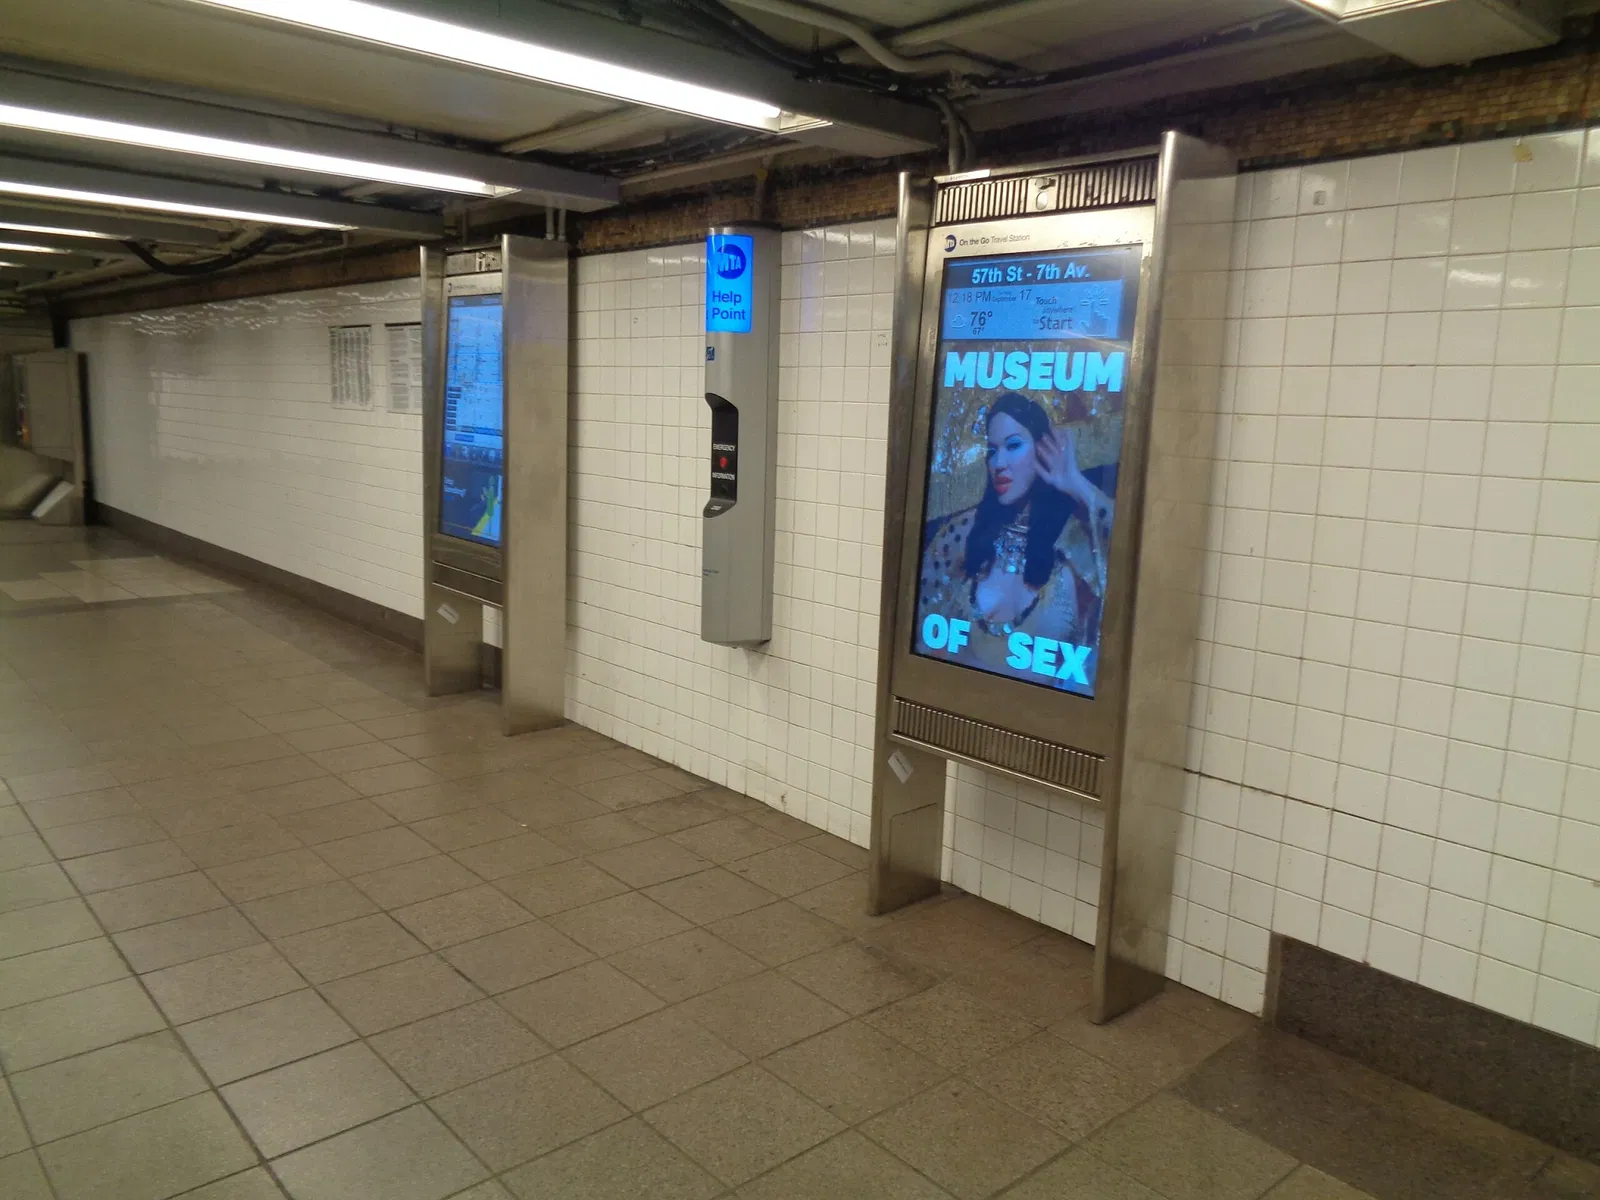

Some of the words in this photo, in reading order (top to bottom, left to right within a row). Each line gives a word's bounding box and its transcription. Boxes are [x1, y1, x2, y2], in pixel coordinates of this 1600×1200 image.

[959, 239, 969, 247] On
[980, 237, 990, 245] Go
[991, 235, 1008, 243] Travel
[1009, 234, 1031, 242] Station
[971, 267, 1002, 284] 57th
[1006, 265, 1024, 282] St
[1036, 264, 1061, 281] 7th
[1064, 262, 1090, 279] Av.
[711, 290, 742, 306] Help
[975, 291, 992, 303] PM
[1019, 288, 1032, 301] 17
[1035, 296, 1058, 305] Touch
[711, 307, 746, 320] Point
[1038, 315, 1073, 331] Start
[943, 351, 1125, 393] MUSEUM
[922, 613, 971, 654] OF
[1005, 631, 1092, 686] SEX
